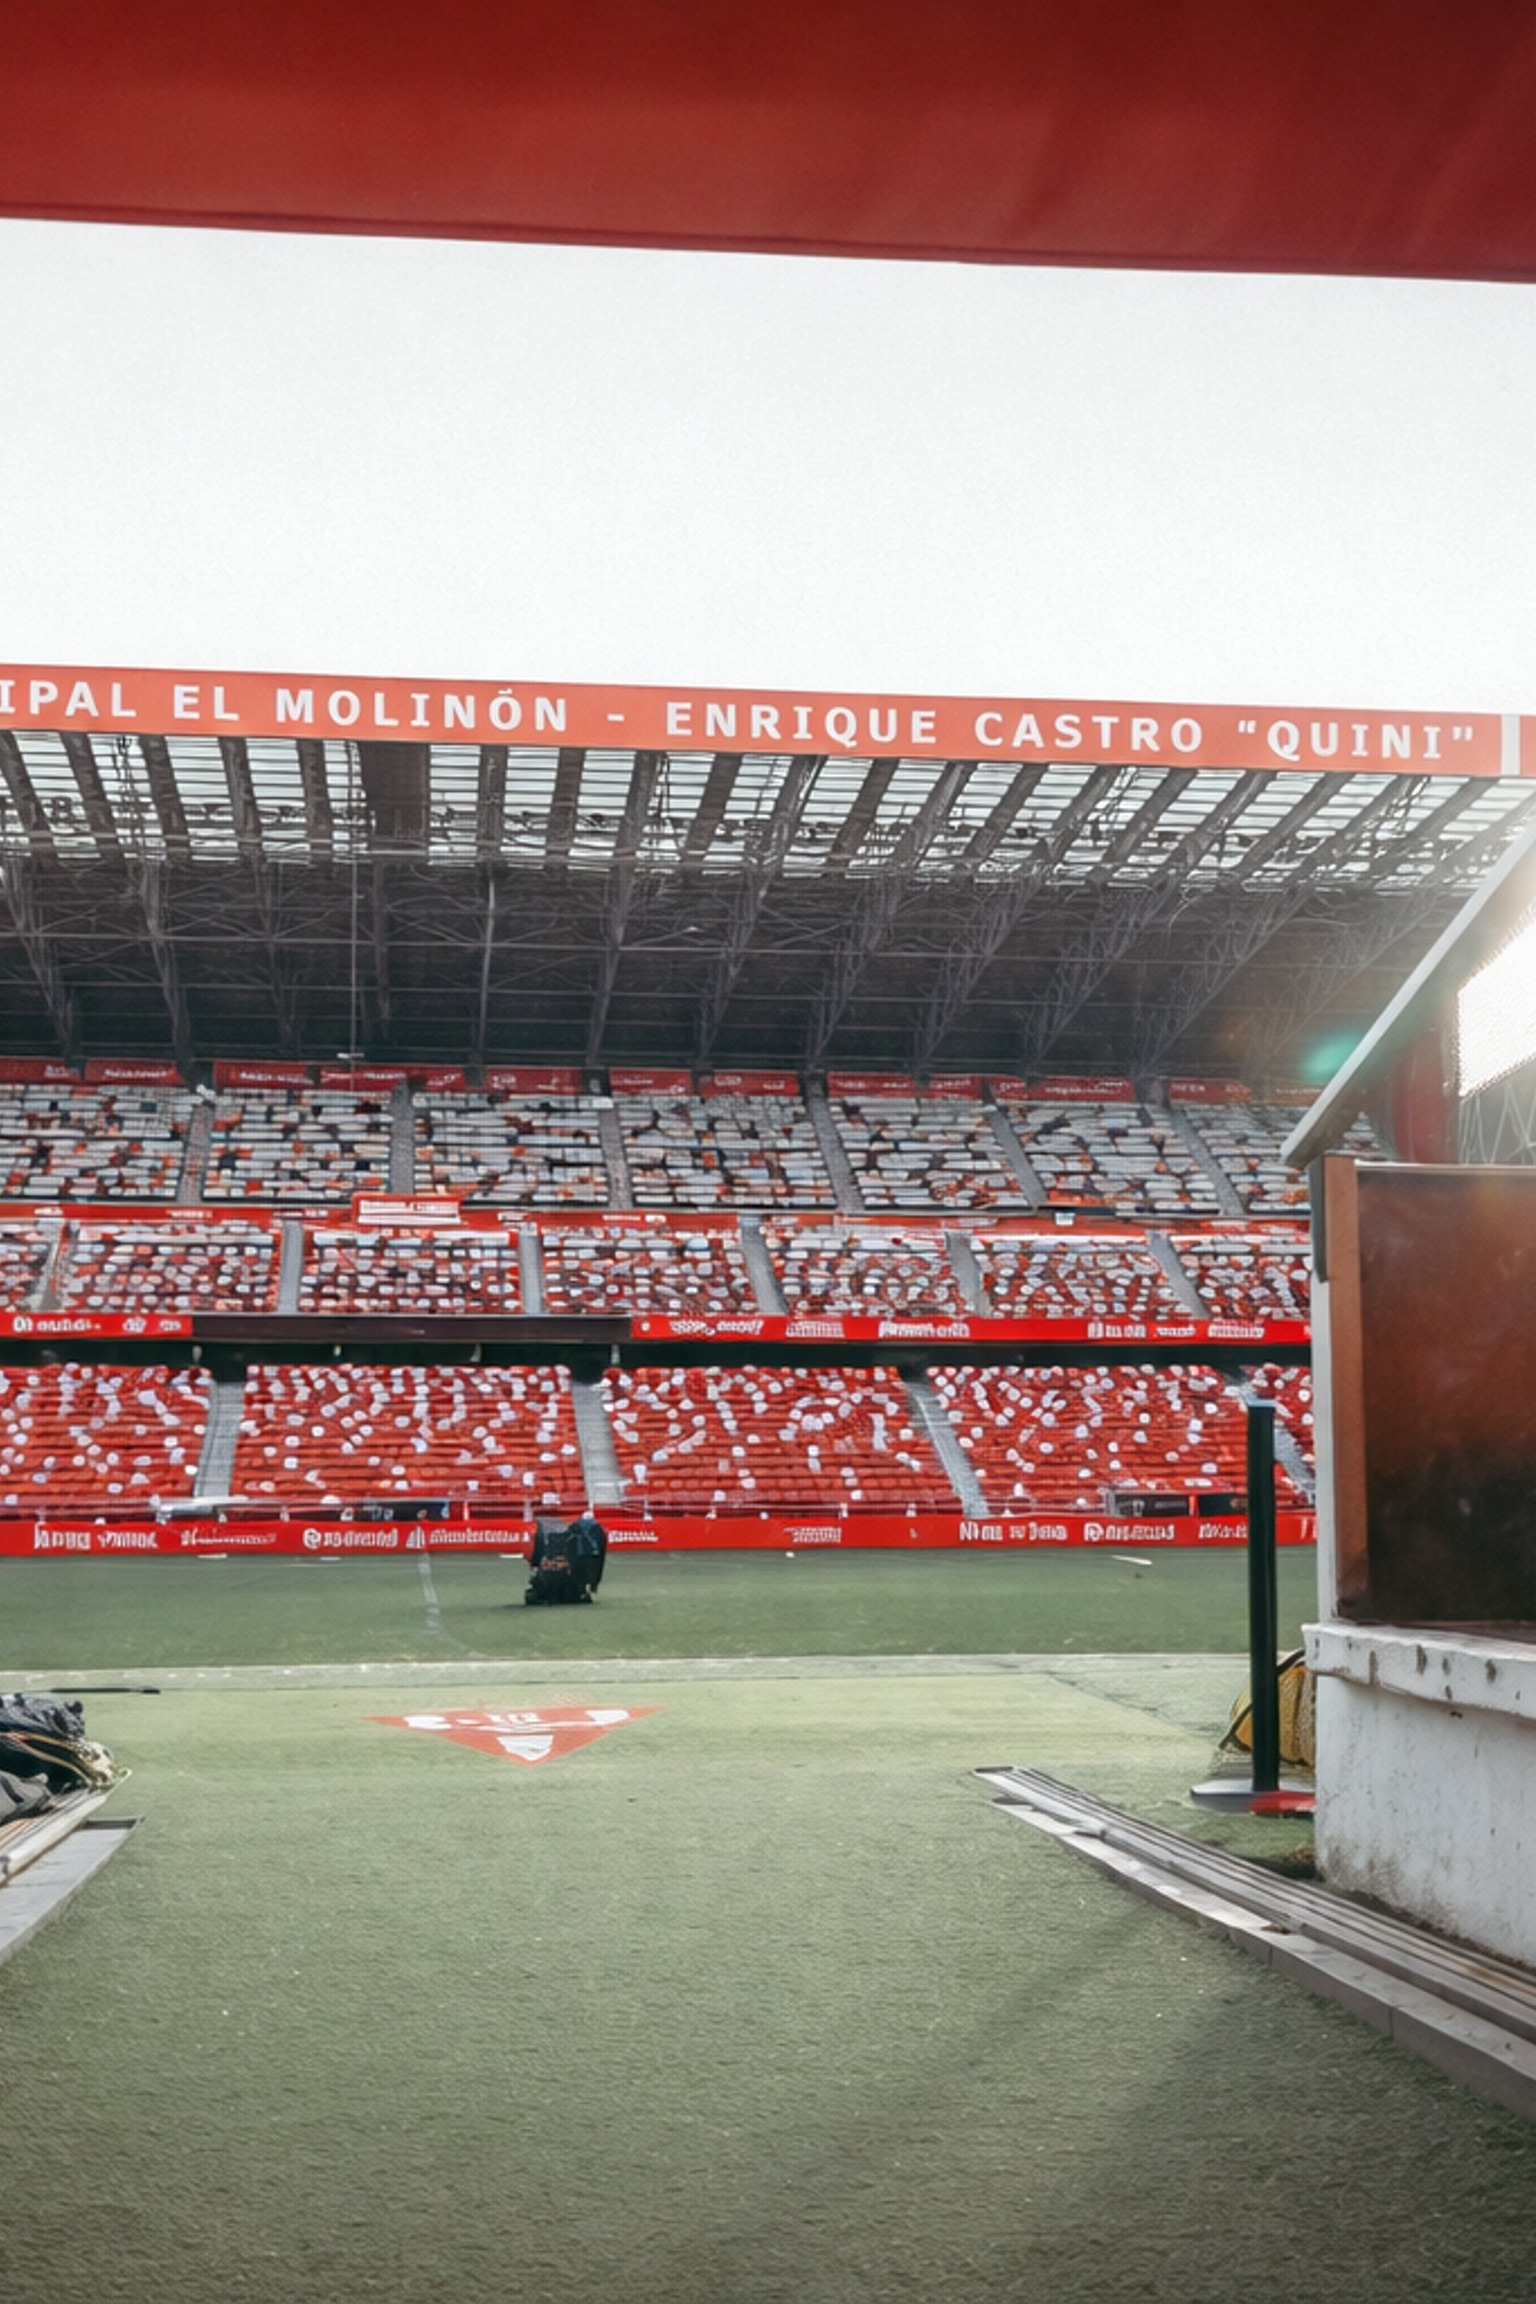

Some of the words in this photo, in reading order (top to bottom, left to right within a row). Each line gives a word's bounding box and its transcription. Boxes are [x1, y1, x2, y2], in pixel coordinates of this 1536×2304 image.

[173, 684, 240, 721] EL
[607, 713, 625, 722] -
[666, 701, 937, 749] ENRIQUE
[974, 711, 1202, 753] CASTRO
